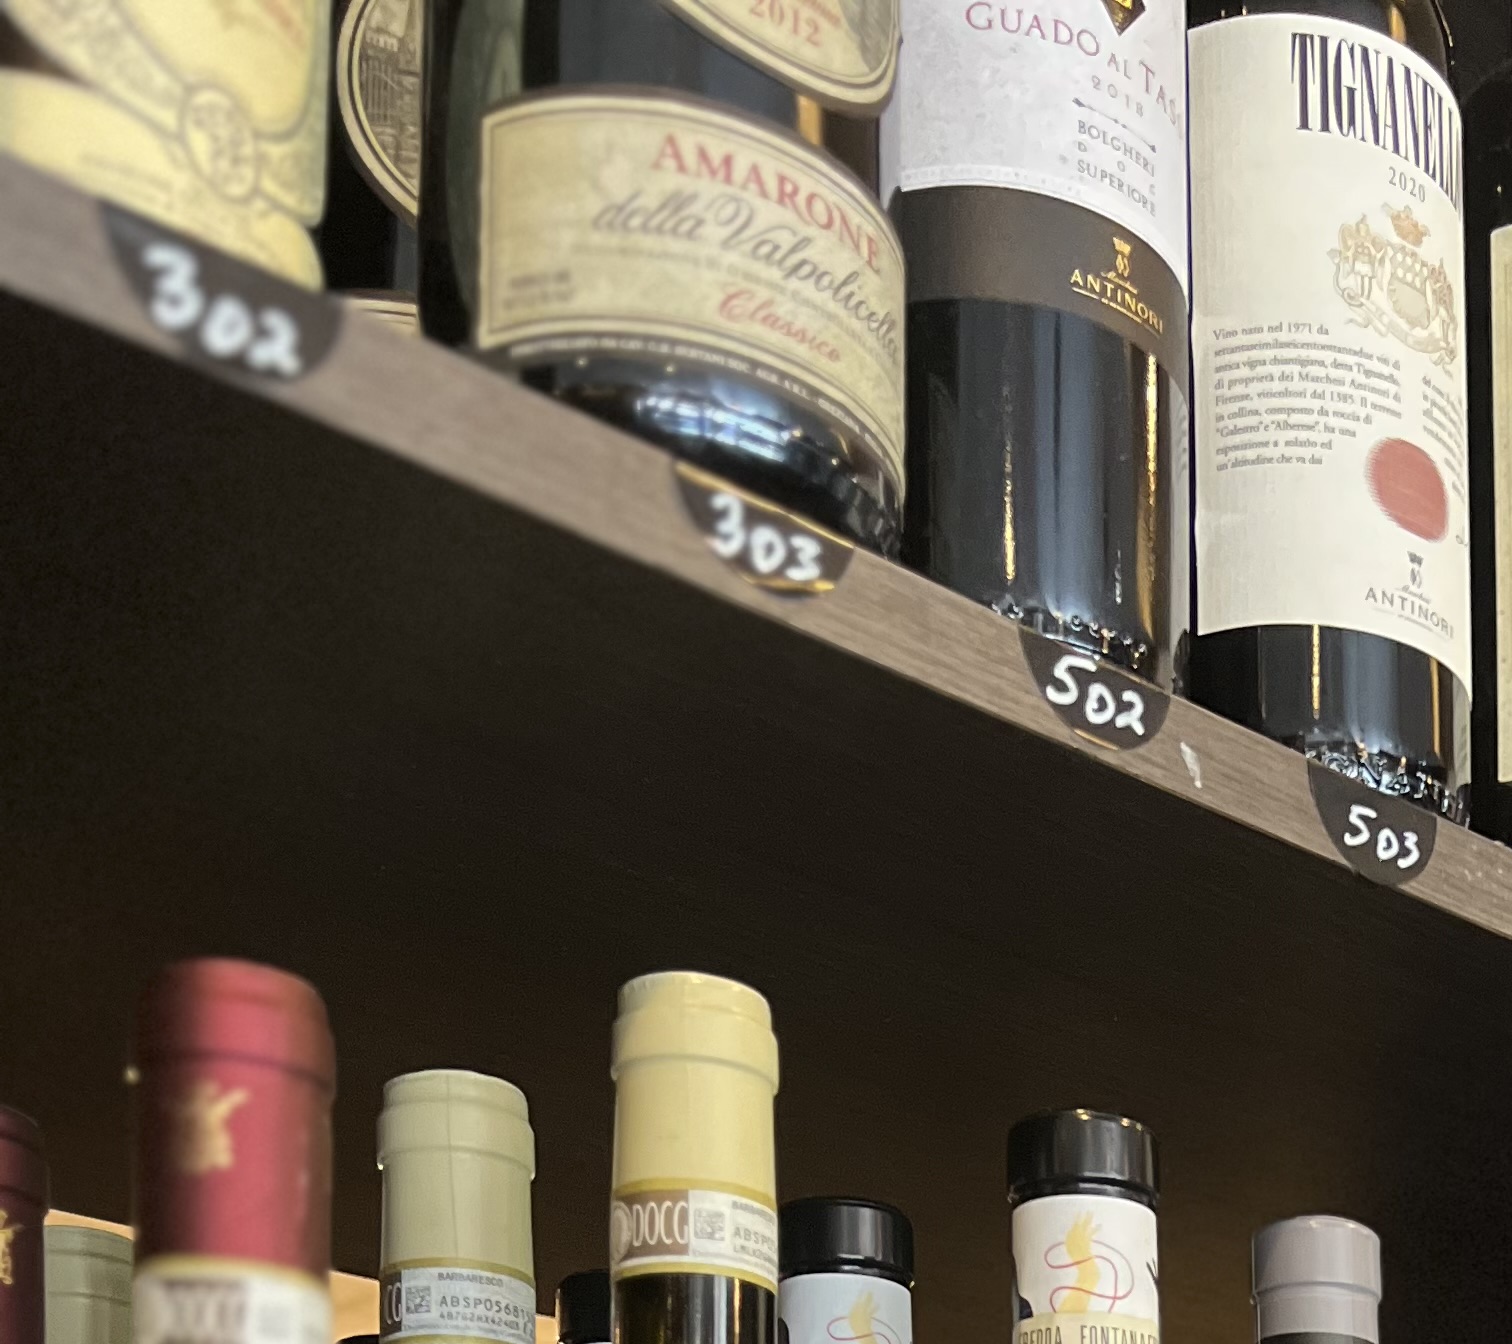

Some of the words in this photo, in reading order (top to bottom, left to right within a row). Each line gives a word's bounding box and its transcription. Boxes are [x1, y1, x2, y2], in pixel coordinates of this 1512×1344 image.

[965, 1, 1100, 57] GUADO
[1107, 52, 1132, 80] AL
[1077, 118, 1156, 178] BOLGHERI
[591, 188, 706, 243] della
[651, 131, 881, 276] AMARONE
[1076, 158, 1157, 218] SUPERIORE
[1387, 165, 1427, 204] 2020
[143, 242, 303, 378] 302
[717, 285, 843, 364] Classico
[1070, 268, 1164, 335] ANTINORI
[1213, 325, 1238, 341] Vino
[1267, 321, 1283, 333] nel
[1287, 321, 1312, 334] 1971
[1316, 323, 1329, 336] da
[708, 490, 823, 584] 303
[1363, 587, 1455, 640] ANTINORI
[1045, 653, 1147, 737] 502
[1342, 802, 1421, 870] 503
[632, 1200, 688, 1248] DOCG
[437, 1271, 504, 1289] BARBARESCO
